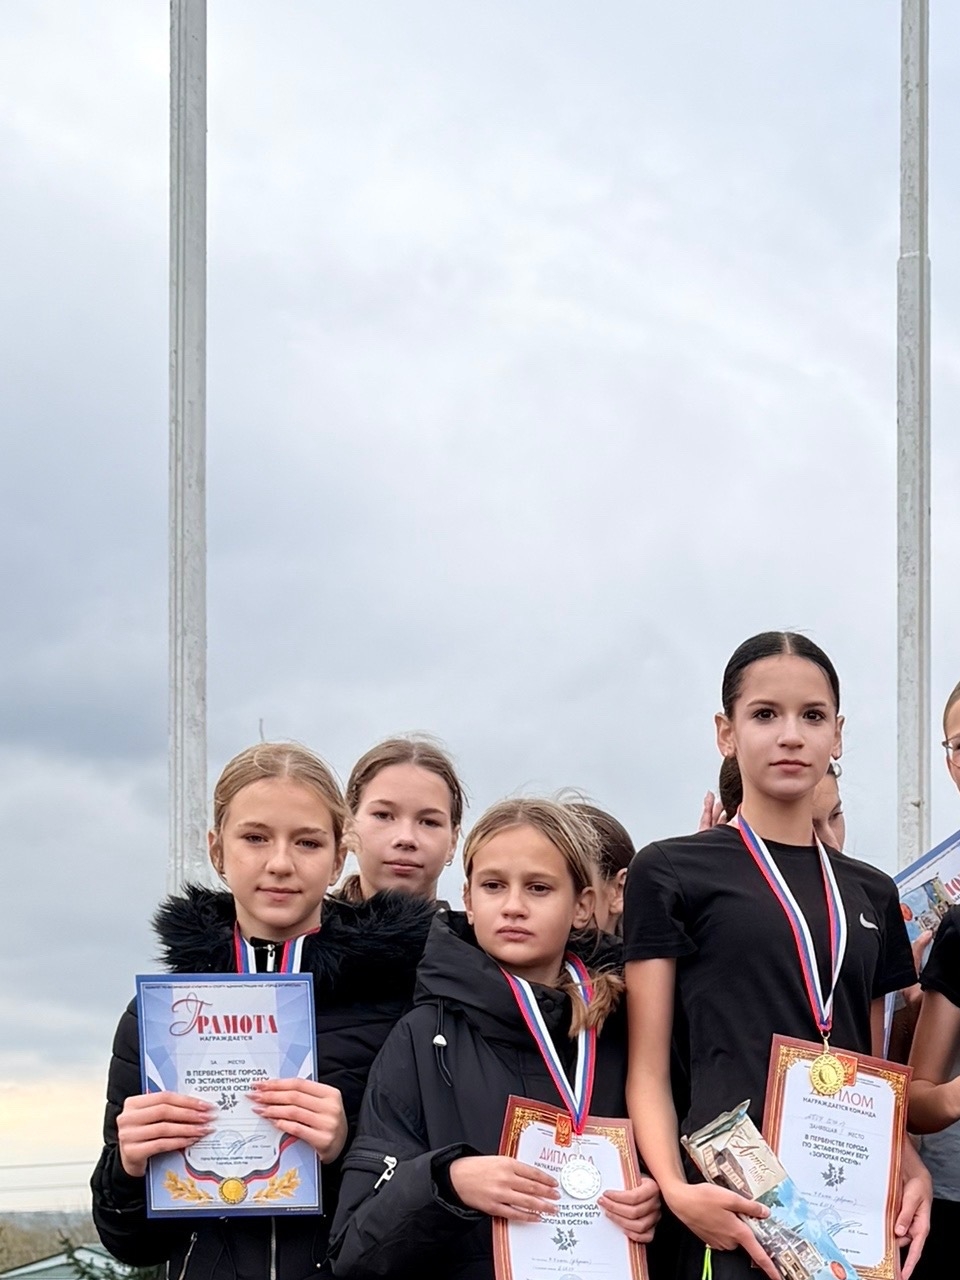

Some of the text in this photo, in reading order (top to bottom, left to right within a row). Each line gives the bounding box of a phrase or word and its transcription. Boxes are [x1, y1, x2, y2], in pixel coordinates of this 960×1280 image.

[193, 1069, 237, 1077] ПЕРВЕНСТВЕ
[198, 1077, 251, 1085] ЭСТАФЕТНОМУ
[803, 1097, 876, 1118] НАГРАЖДАЕТСЯ КОМАНДА
[810, 1134, 845, 1147] ПЕРВЕНСТВЕ
[845, 1143, 868, 1152] ГОРОДА
[813, 1143, 855, 1157] ЭСТАФЕТНОМУ
[855, 1152, 869, 1160] БЕГУ
